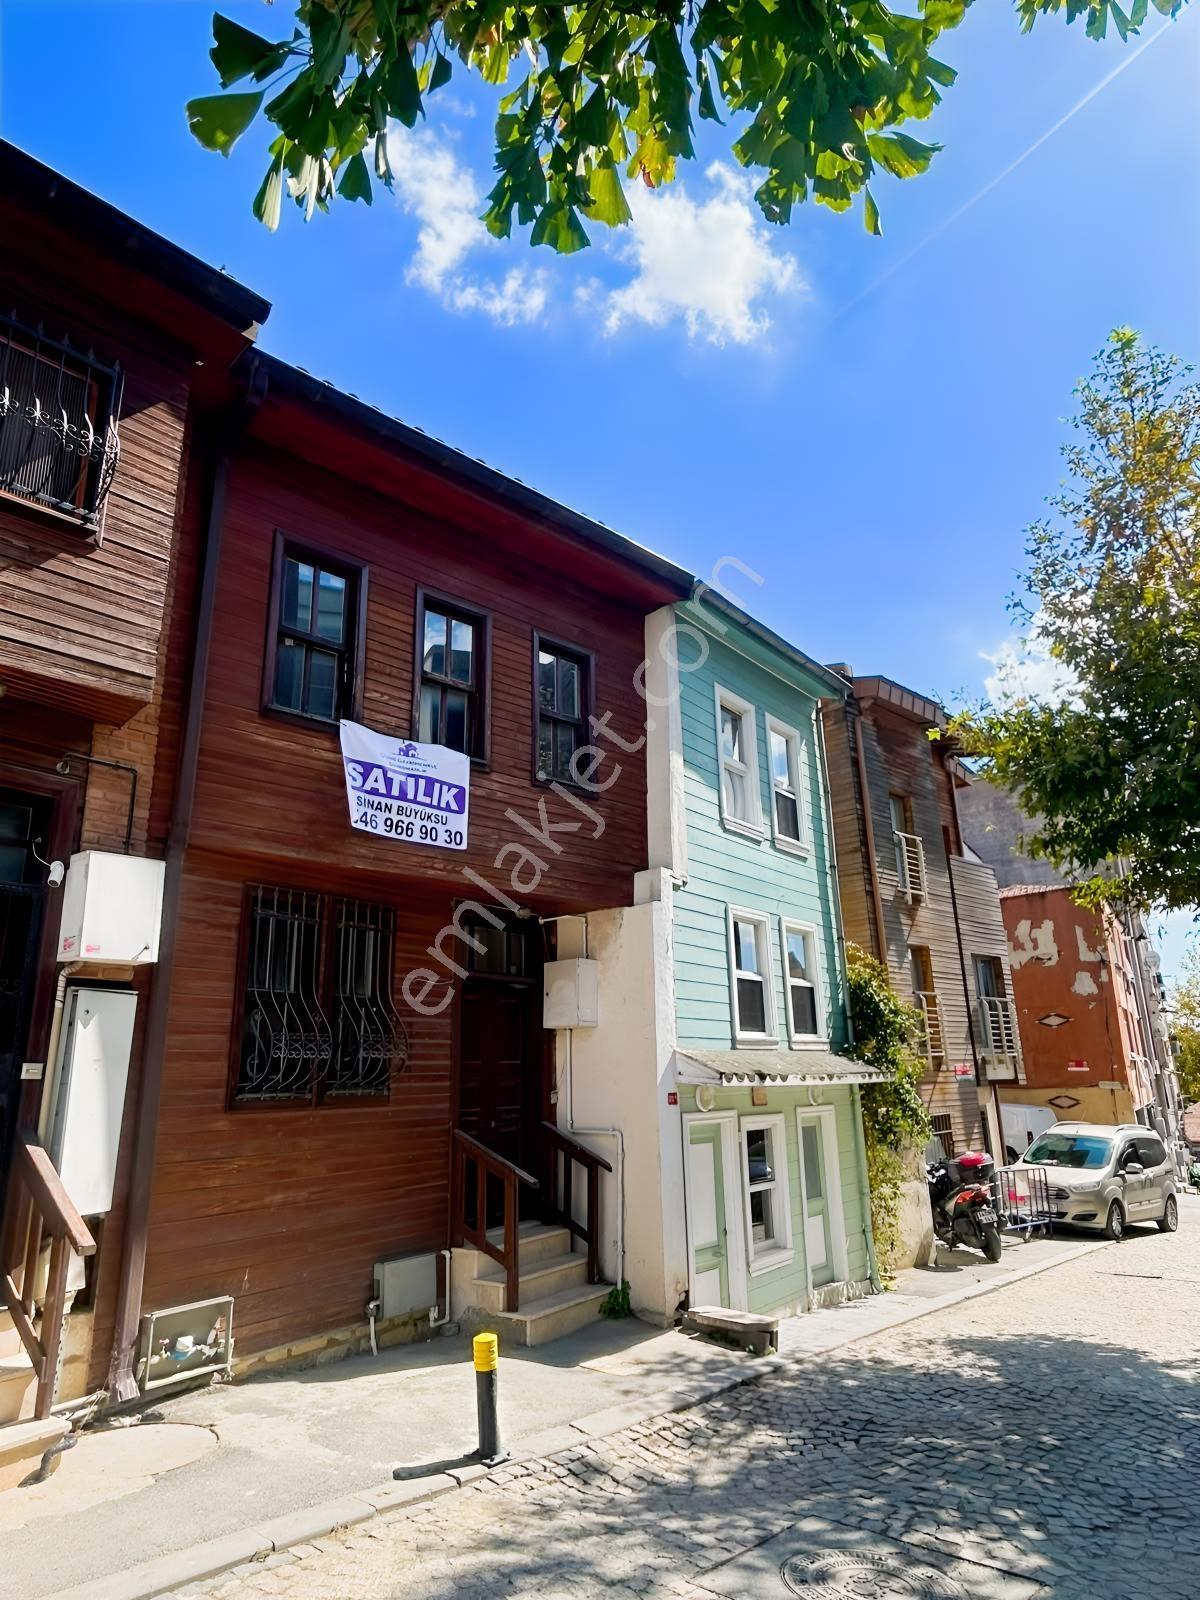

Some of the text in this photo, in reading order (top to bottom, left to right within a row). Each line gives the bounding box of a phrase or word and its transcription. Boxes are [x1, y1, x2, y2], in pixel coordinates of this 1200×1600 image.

[347, 763, 459, 810] SATILIK
[356, 795, 448, 825] SİNAN BÜYÜKSU
[383, 817, 415, 838] 966
[419, 825, 439, 842] 90
[444, 829, 463, 846] 30
